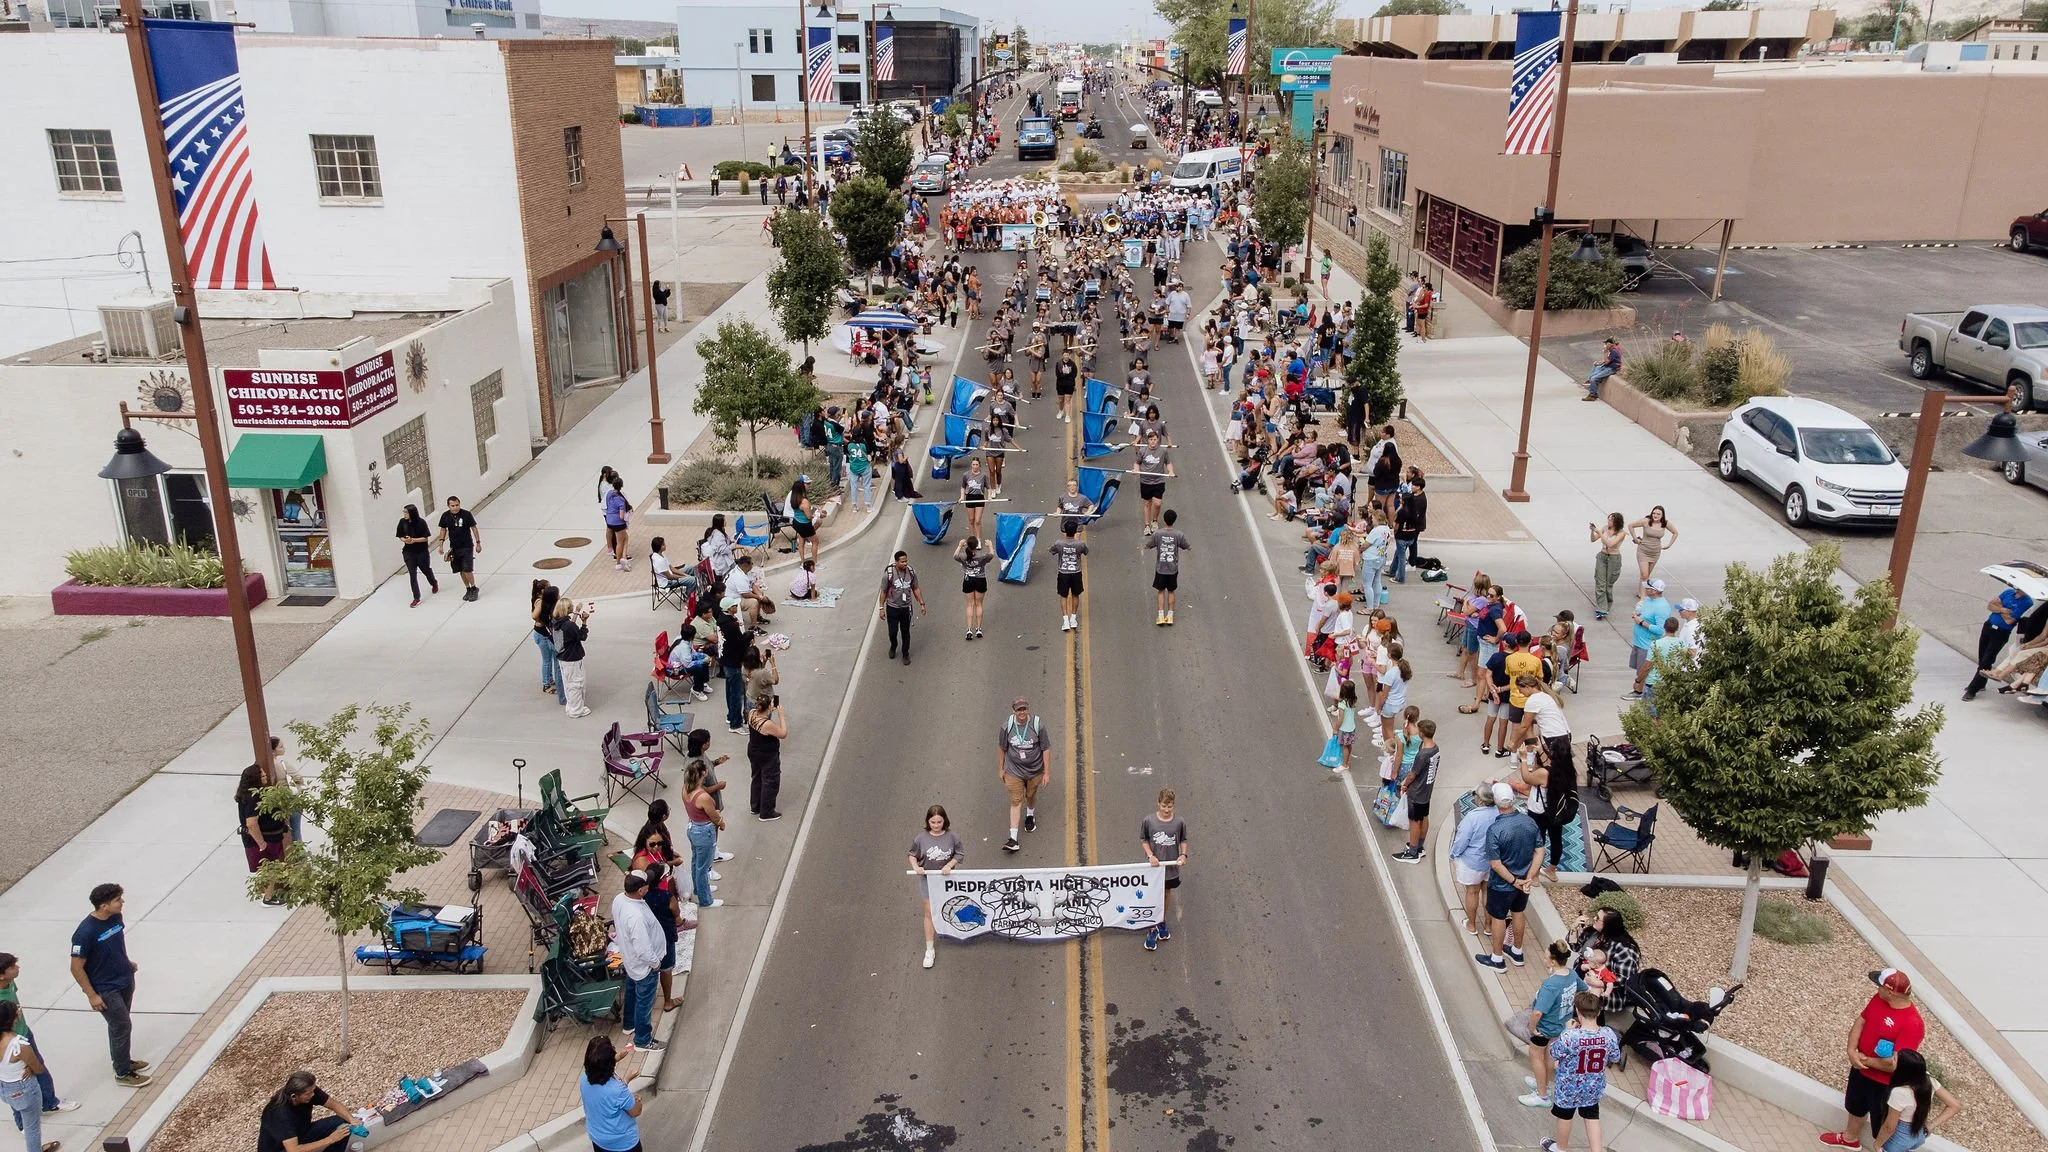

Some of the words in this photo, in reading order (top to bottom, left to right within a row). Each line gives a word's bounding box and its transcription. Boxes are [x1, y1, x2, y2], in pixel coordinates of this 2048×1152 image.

[355, 356, 384, 378] SUNRISE
[251, 372, 318, 385] SUNRISE
[347, 366, 395, 398] CHIROPRACTIC
[228, 388, 345, 400] CHIROPRACTIC
[238, 404, 340, 416] 505-324-2080
[233, 418, 350, 427] sunrisechirofarmington.com
[851, 448, 862, 458] 34
[128, 489, 146, 497] OPEN
[944, 881, 996, 893] PIEDRA
[1004, 880, 1044, 892] VISTA
[1050, 879, 1084, 891] HIGH
[1131, 908, 1153, 919] 39
[1580, 1037, 1606, 1047] GOOCH
[1575, 1048, 1606, 1075] 18
